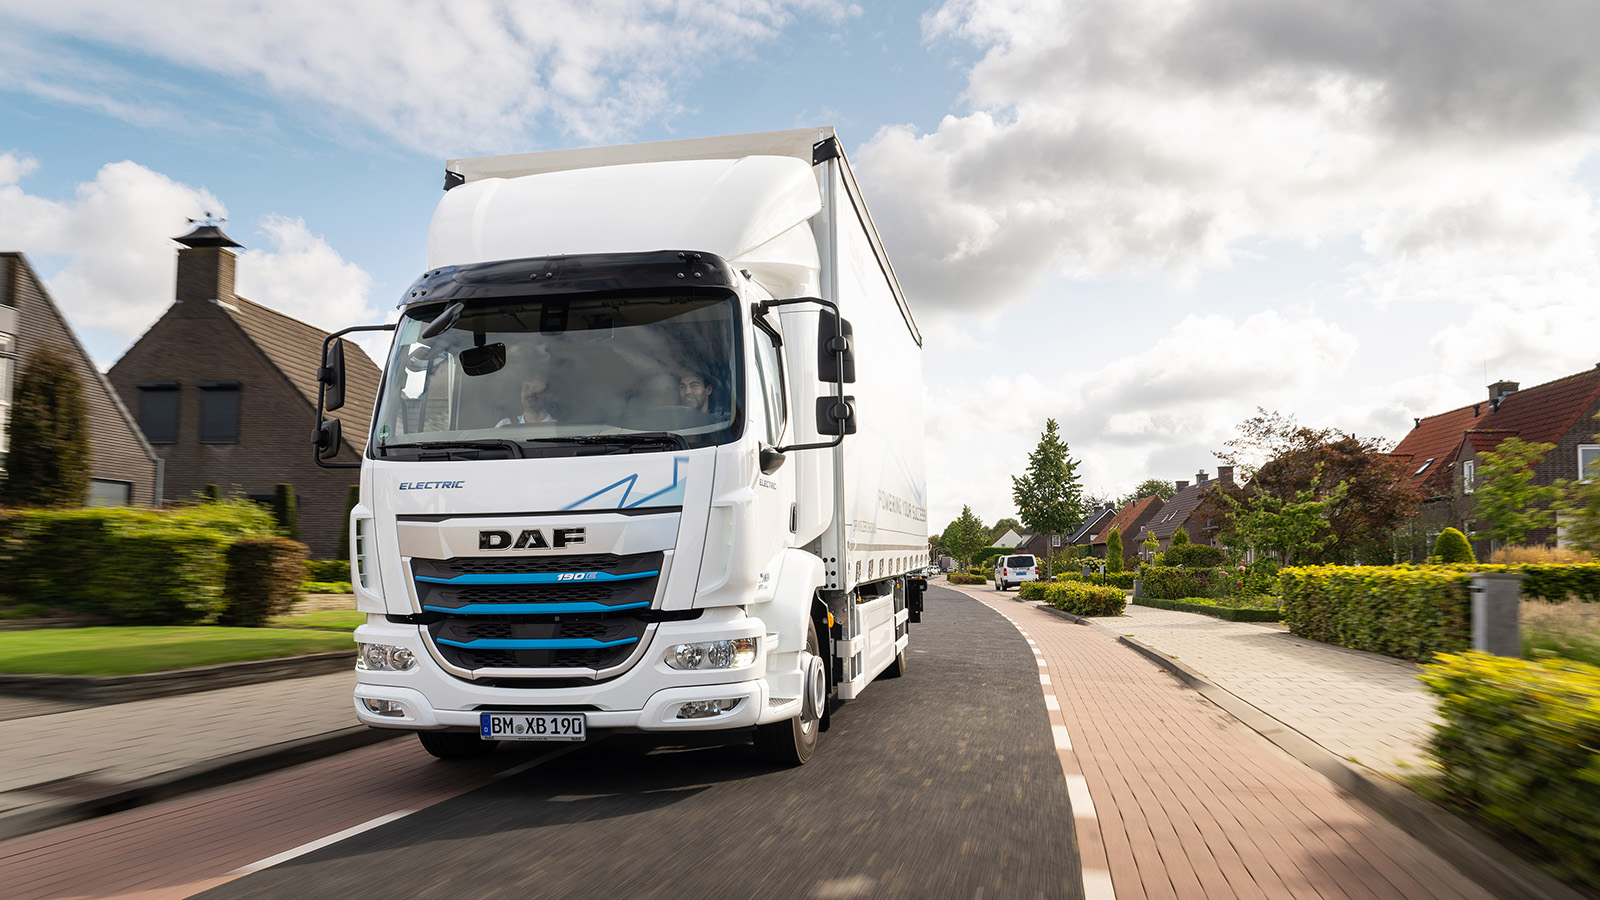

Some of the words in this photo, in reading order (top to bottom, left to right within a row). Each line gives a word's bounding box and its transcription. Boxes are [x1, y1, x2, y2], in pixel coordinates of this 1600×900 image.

[399, 480, 465, 490] ELECTRIC
[479, 527, 586, 551] DAF
[492, 717, 514, 734] BM
[525, 717, 547, 734] XB
[550, 717, 582, 734] 190
